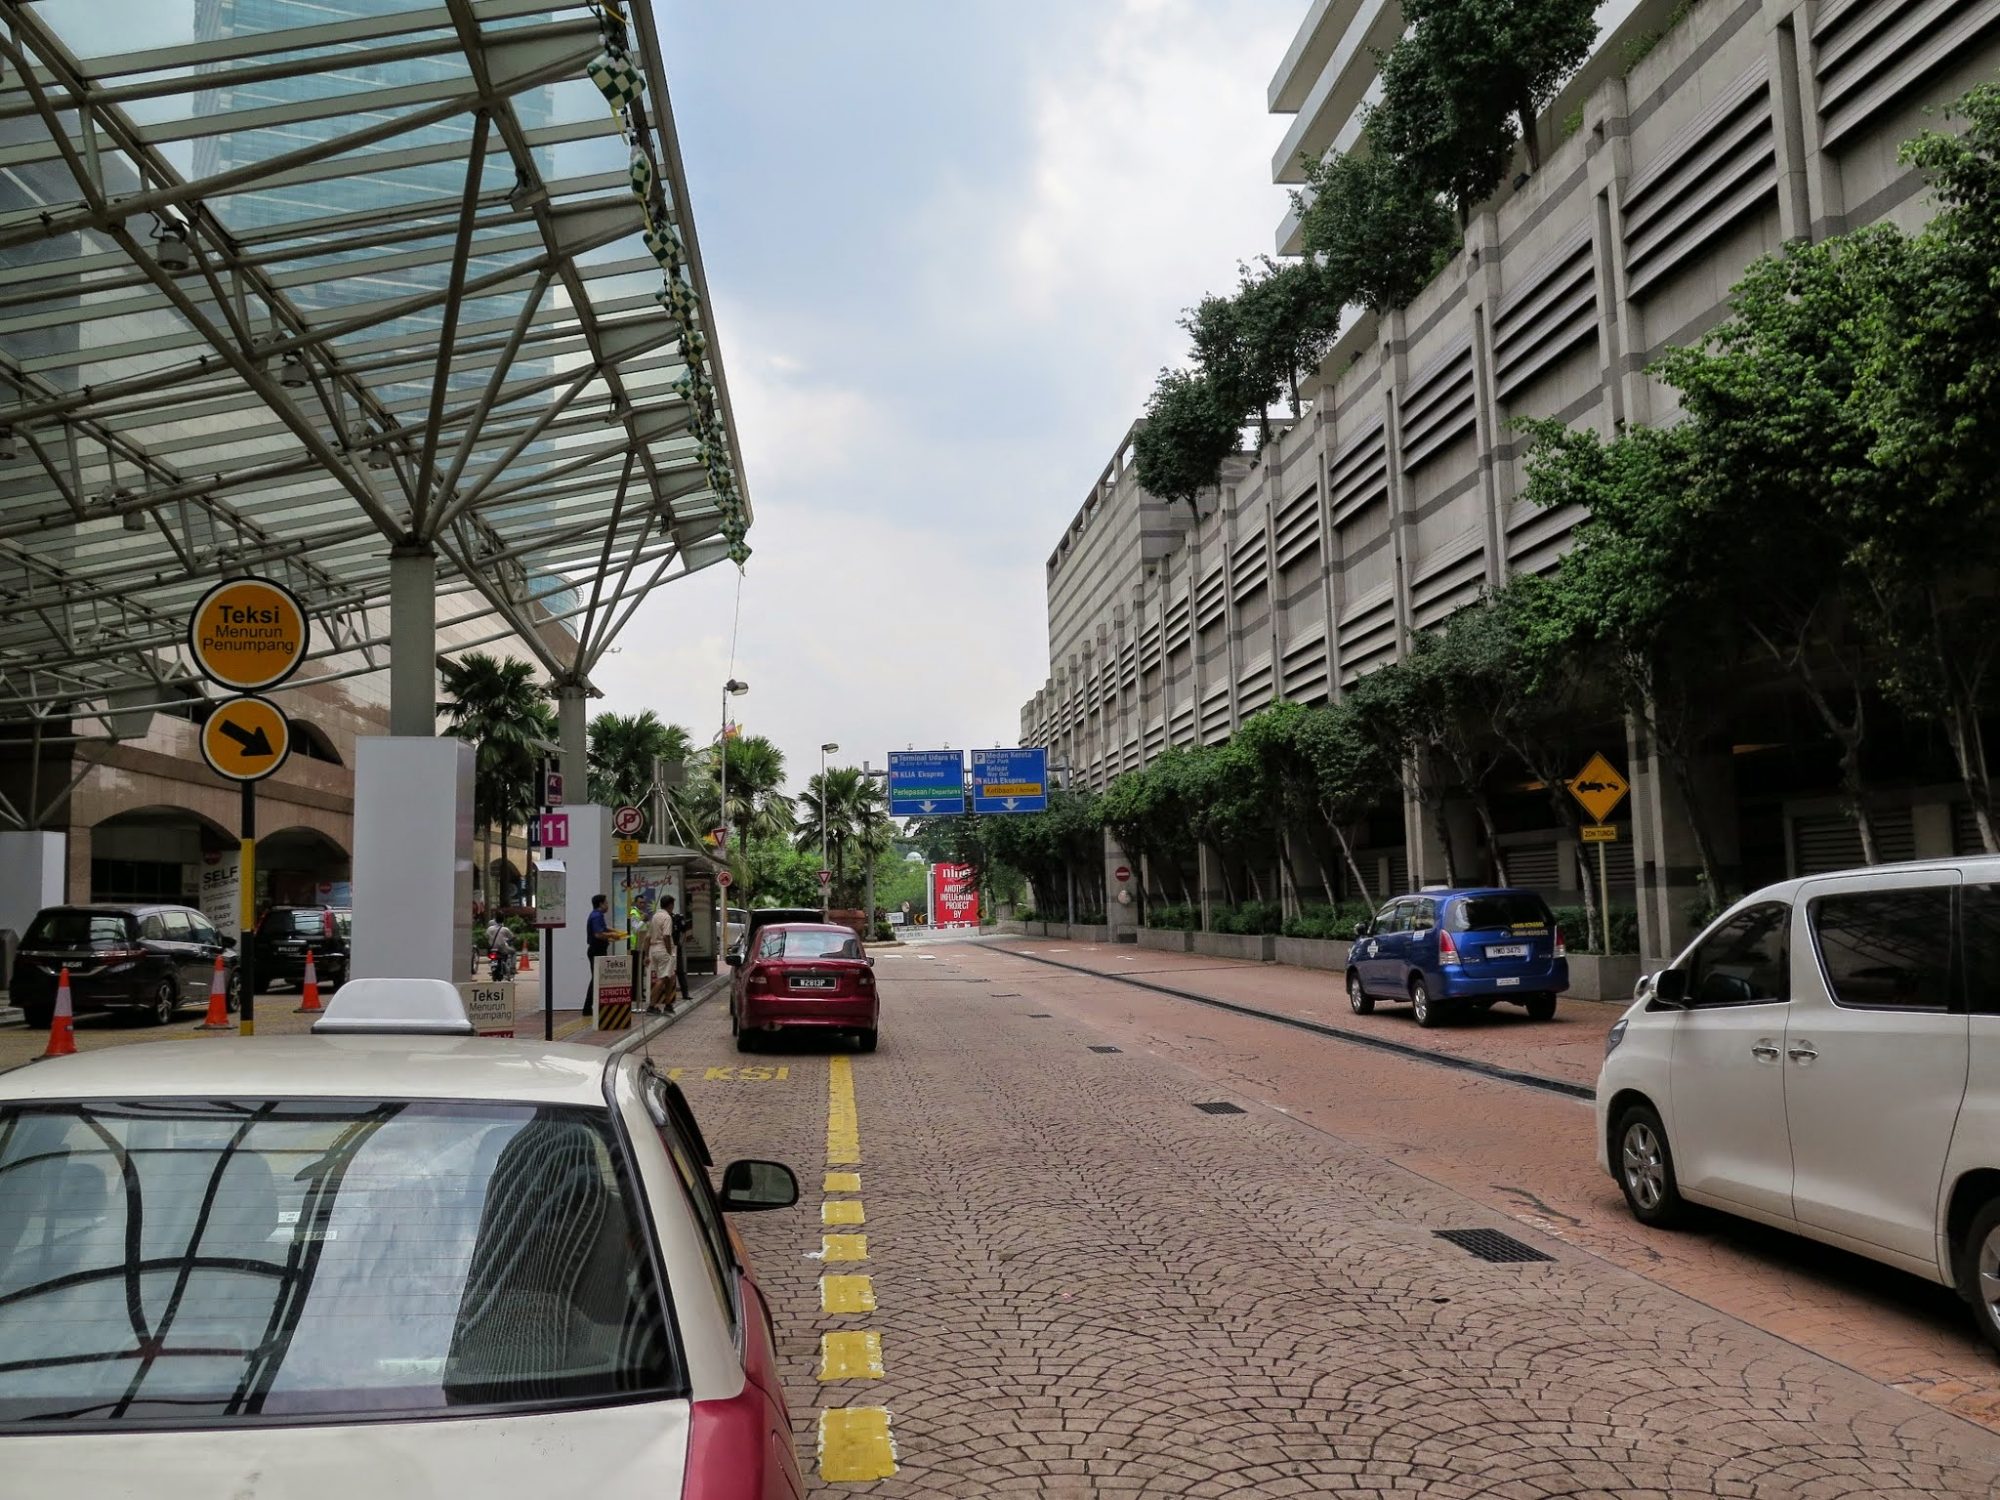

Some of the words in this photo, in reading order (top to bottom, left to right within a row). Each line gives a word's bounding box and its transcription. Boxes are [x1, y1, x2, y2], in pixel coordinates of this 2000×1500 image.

[218, 605, 280, 624] Teksi
[215, 624, 283, 638] Menurun
[202, 637, 294, 655] Penumpang
[899, 753, 927, 762] Terminal
[950, 752, 960, 761] KL
[543, 820, 567, 842] 11
[203, 866, 238, 884] SELF
[945, 901, 970, 910] PROJECT
[953, 910, 962, 919] BY
[606, 959, 626, 969] Teksi
[471, 988, 504, 1002] Teksi
[600, 987, 631, 997] STRICTLY
[469, 1002, 506, 1011] Menurun
[469, 1010, 512, 1021] enumpang
